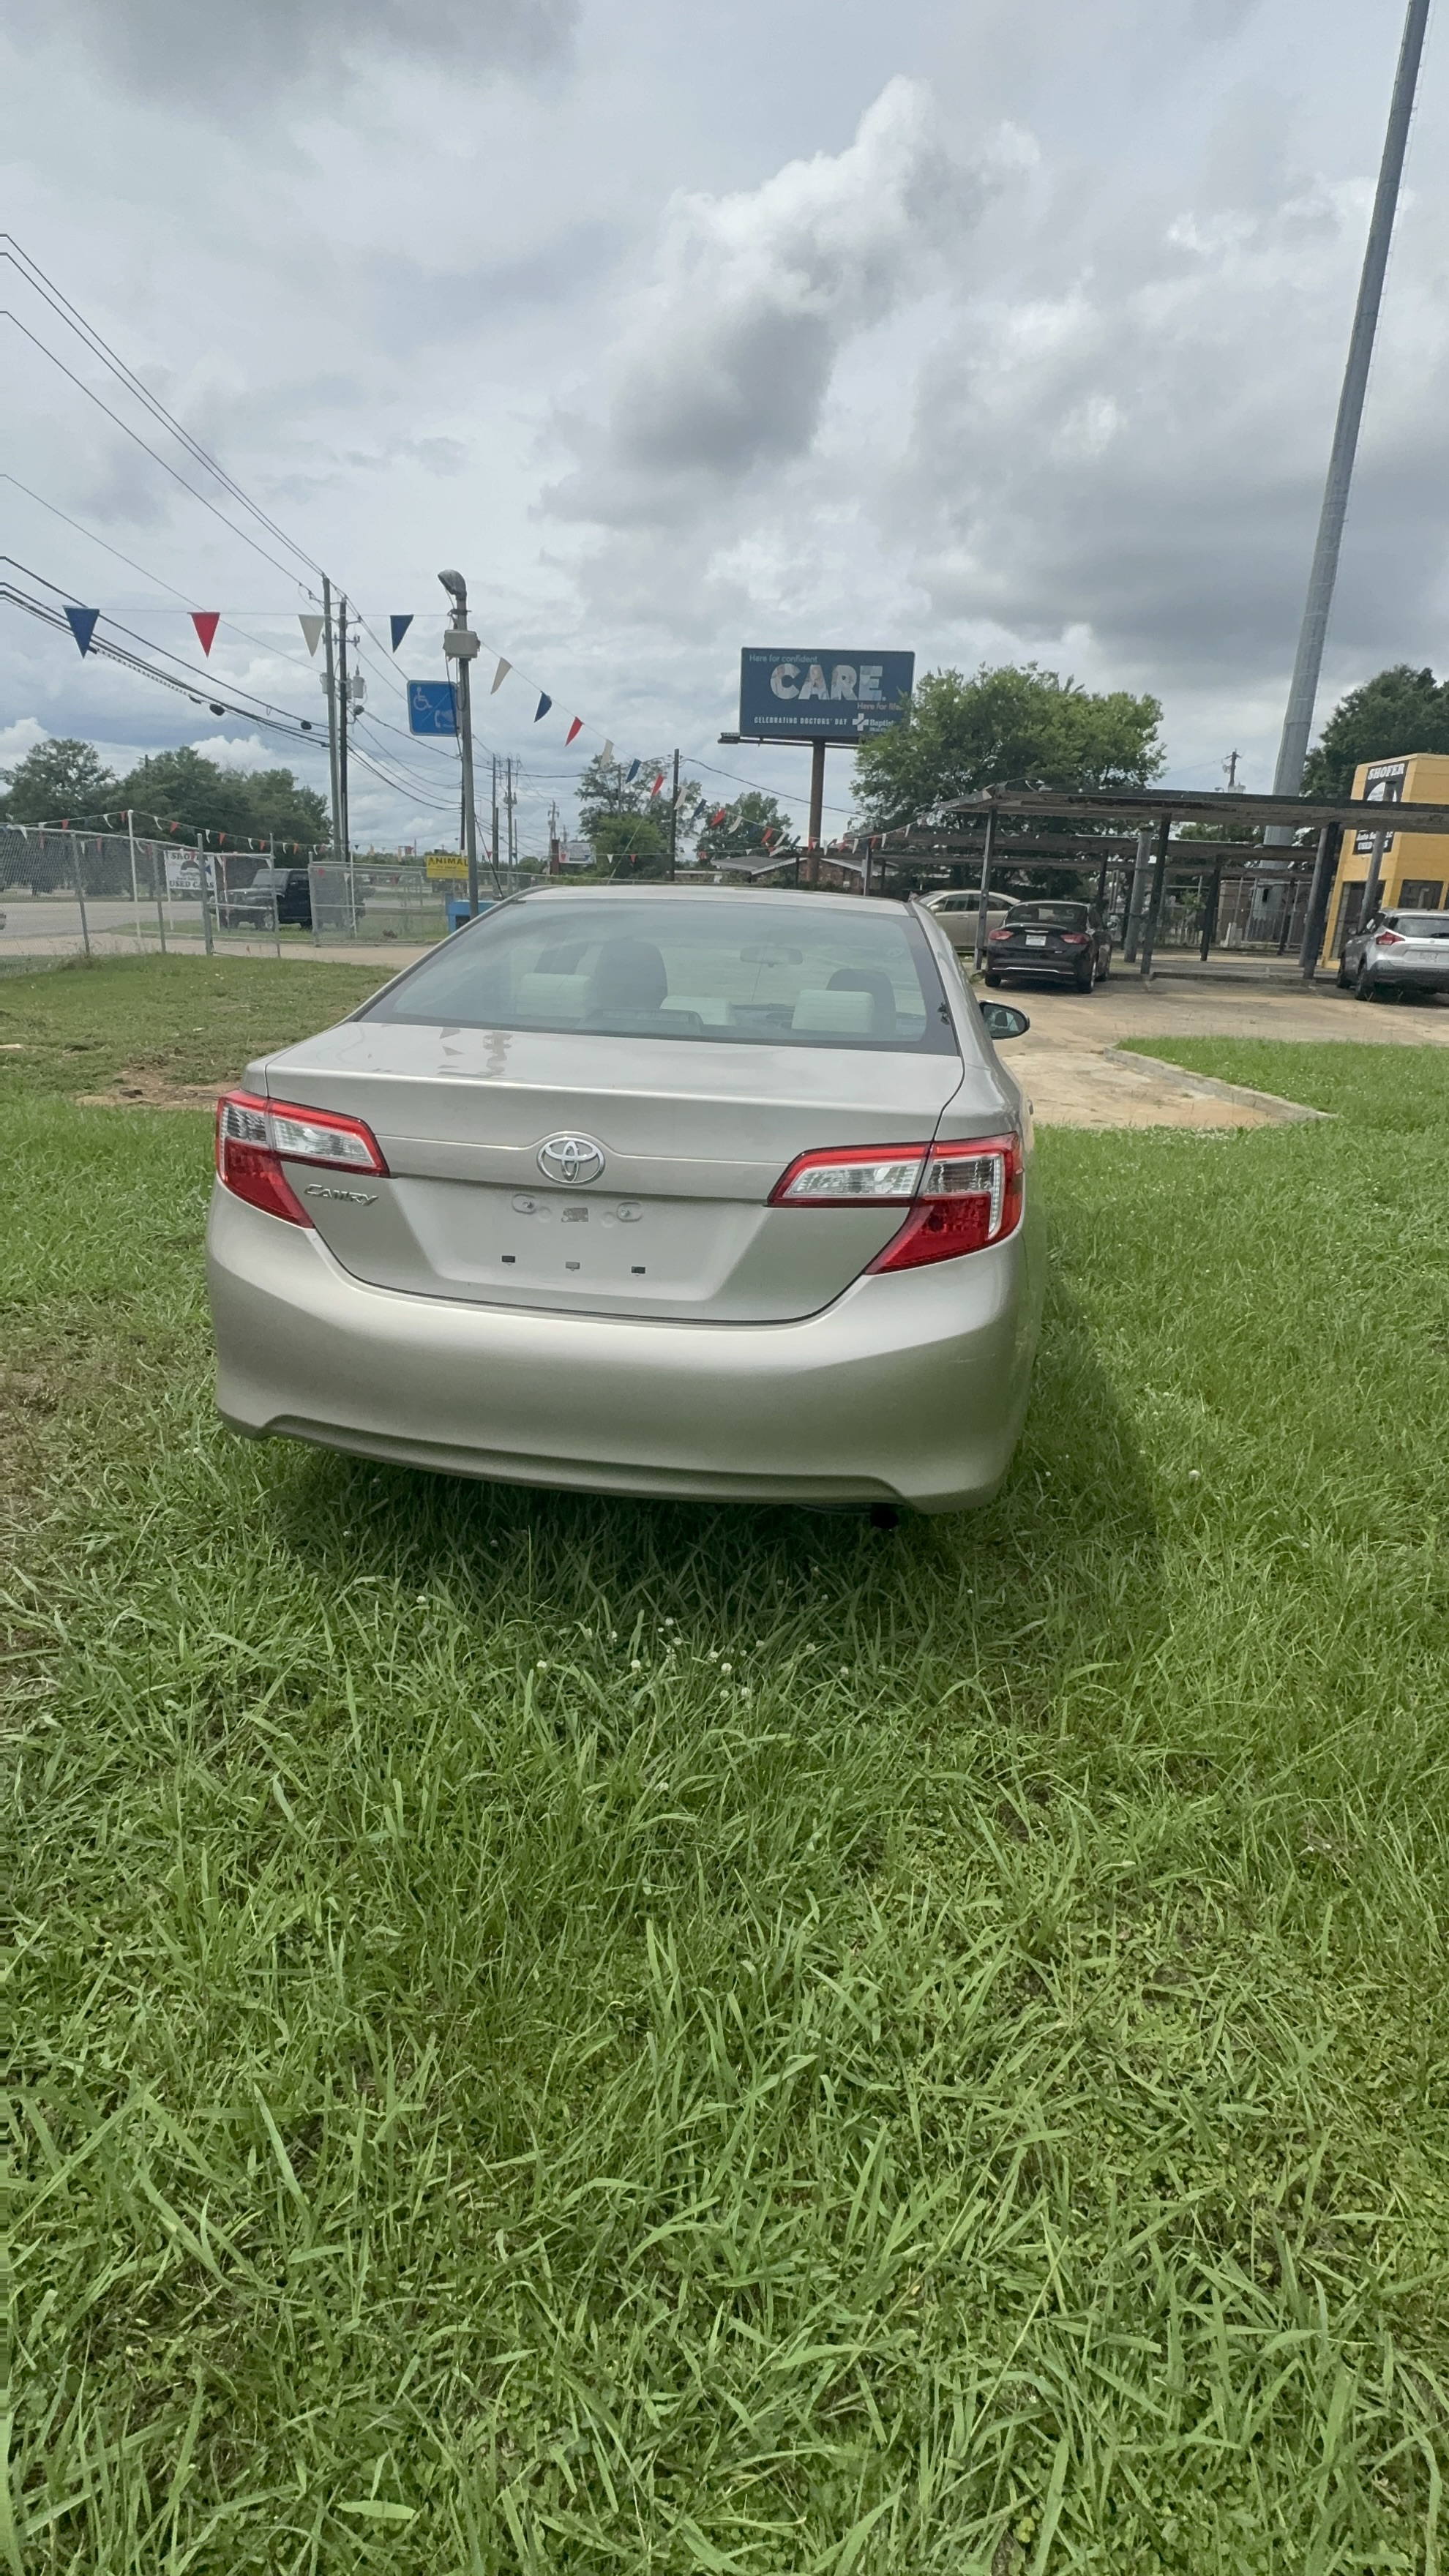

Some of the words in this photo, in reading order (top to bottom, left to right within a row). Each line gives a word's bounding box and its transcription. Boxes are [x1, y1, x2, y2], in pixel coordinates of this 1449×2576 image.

[749, 654, 767, 662] Here
[769, 654, 780, 662] for
[782, 654, 817, 663] confident
[1368, 763, 1404, 779] SHOFER
[428, 856, 469, 866] ANIMAL
[304, 1184, 378, 1207] CAMRY
